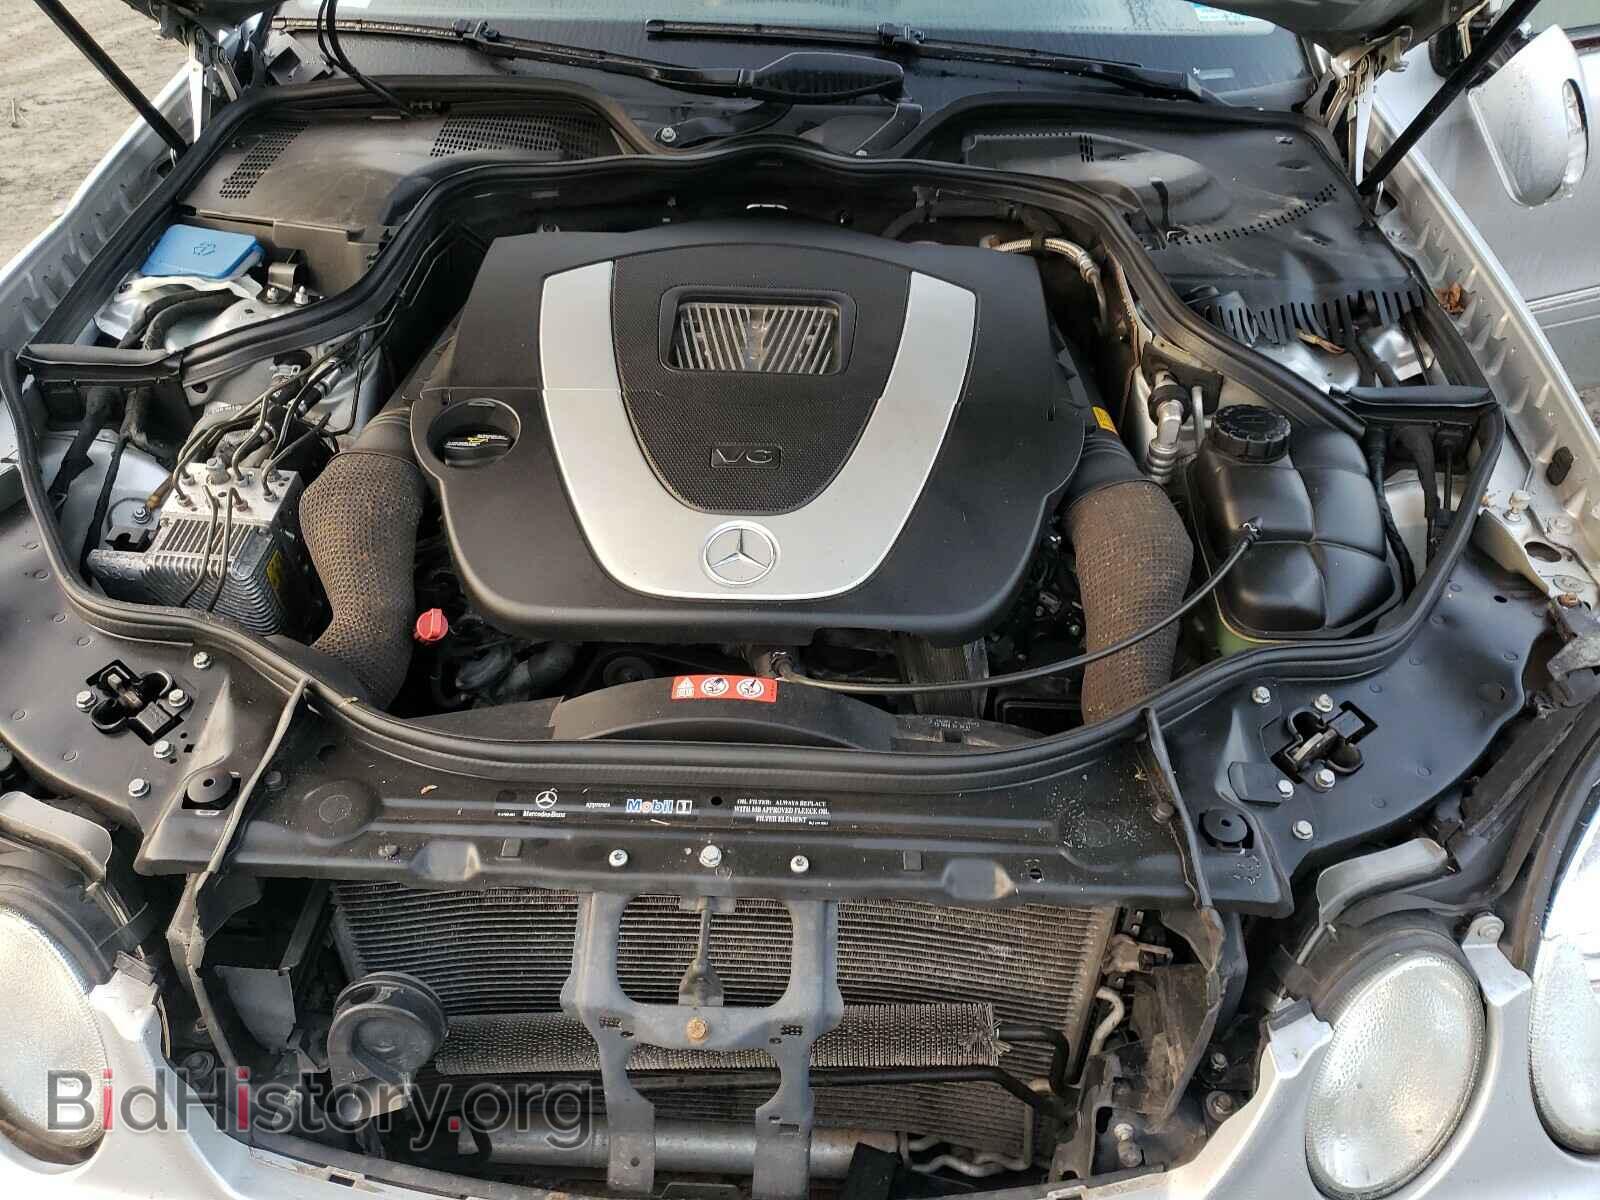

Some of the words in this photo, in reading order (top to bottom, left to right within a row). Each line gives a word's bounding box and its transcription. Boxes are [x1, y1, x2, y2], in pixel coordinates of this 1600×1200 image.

[715, 447, 774, 464] V6
[625, 798, 674, 814] Mobil
[761, 806, 793, 814] APPROVED
[794, 807, 818, 815] FLEECE
[777, 815, 807, 823] ELEMENT
